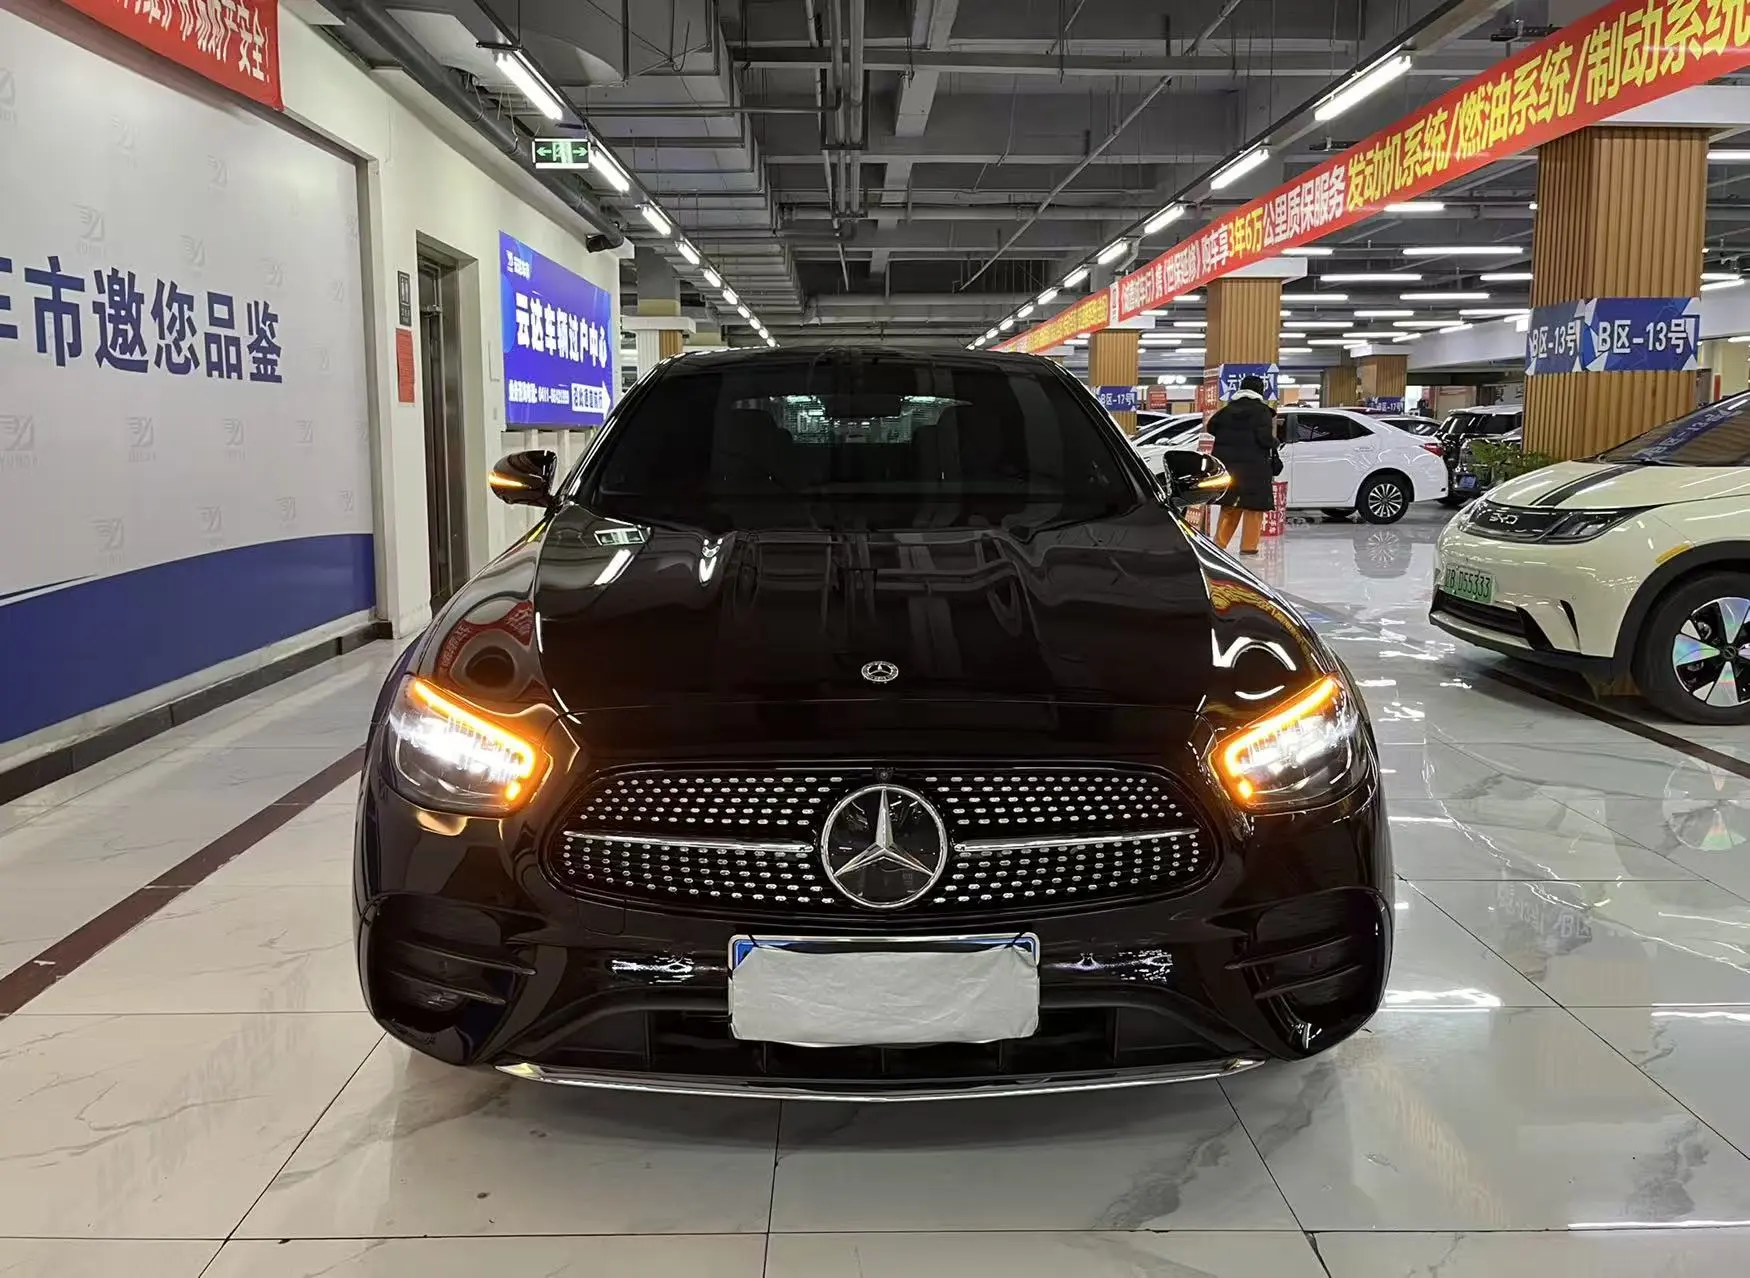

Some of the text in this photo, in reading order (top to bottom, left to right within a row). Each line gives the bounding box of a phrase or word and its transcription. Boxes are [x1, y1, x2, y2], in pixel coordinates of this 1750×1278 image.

[1347, 0, 1750, 211] 发动机系统/燃油系统/制动系统
[0, 255, 282, 384] 市邀您品鉴
[516, 292, 608, 369] 云达车辆过户中心
[1531, 321, 1577, 359] B区-13号
[1598, 318, 1687, 354] B区-13号
[1100, 393, 1133, 406] B区-17号
